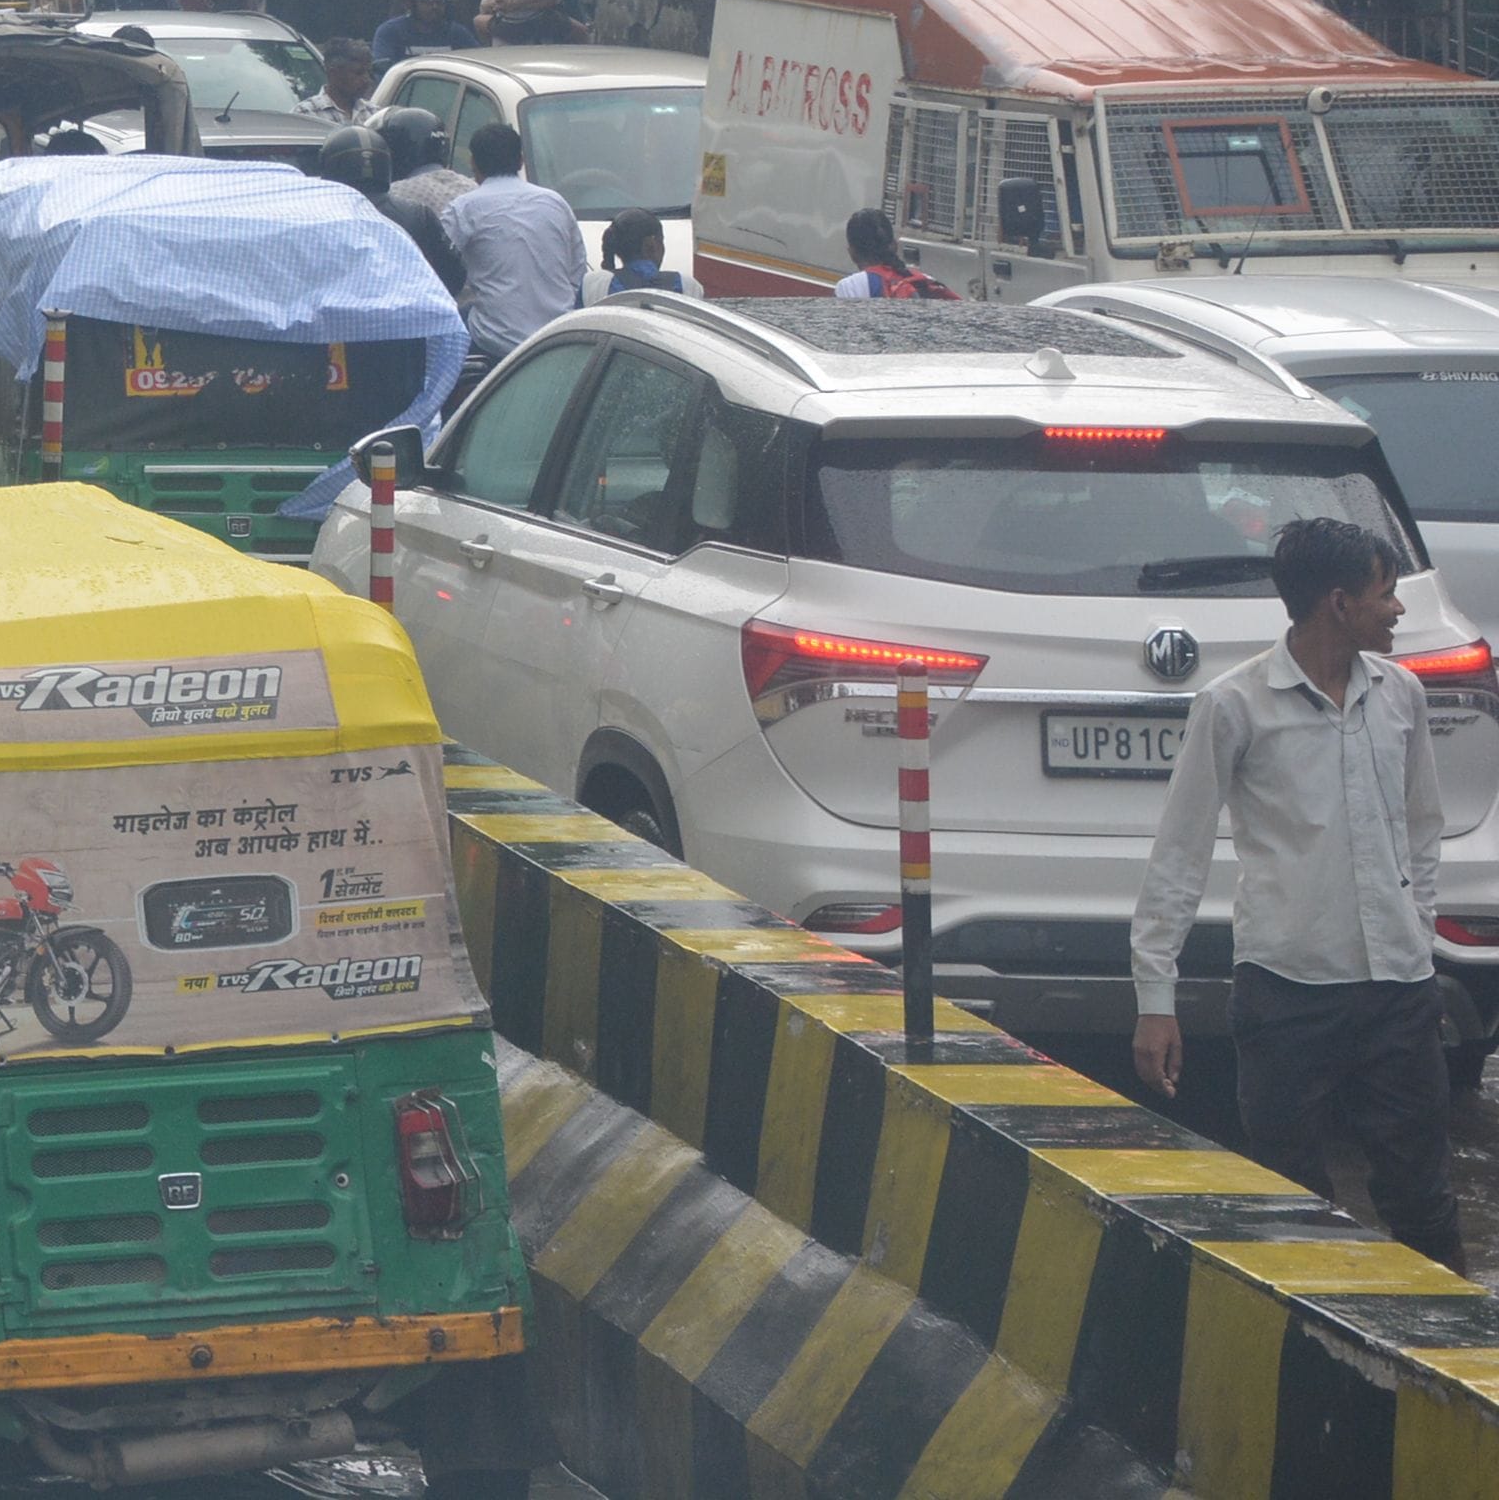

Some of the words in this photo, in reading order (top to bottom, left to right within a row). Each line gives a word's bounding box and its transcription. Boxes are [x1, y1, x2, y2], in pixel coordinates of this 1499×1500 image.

[1151, 635, 1195, 677] MG
[18, 665, 282, 712] Radeon
[150, 706, 181, 724] जियो
[184, 703, 213, 725] बुलंद
[241, 700, 271, 721] बुलंद
[1051, 736, 1070, 748] IND
[330, 766, 373, 783] TVS
[113, 805, 191, 836] माइलेज
[197, 807, 226, 828] का
[233, 799, 298, 831] कंट्रोल
[195, 837, 230, 858] अब
[237, 826, 300, 855] आपके
[307, 828, 347, 853] हाथ
[334, 873, 383, 898] सेगमेंट
[183, 977, 209, 990] नया
[220, 974, 250, 986] TVS
[242, 954, 423, 993] Radeon
